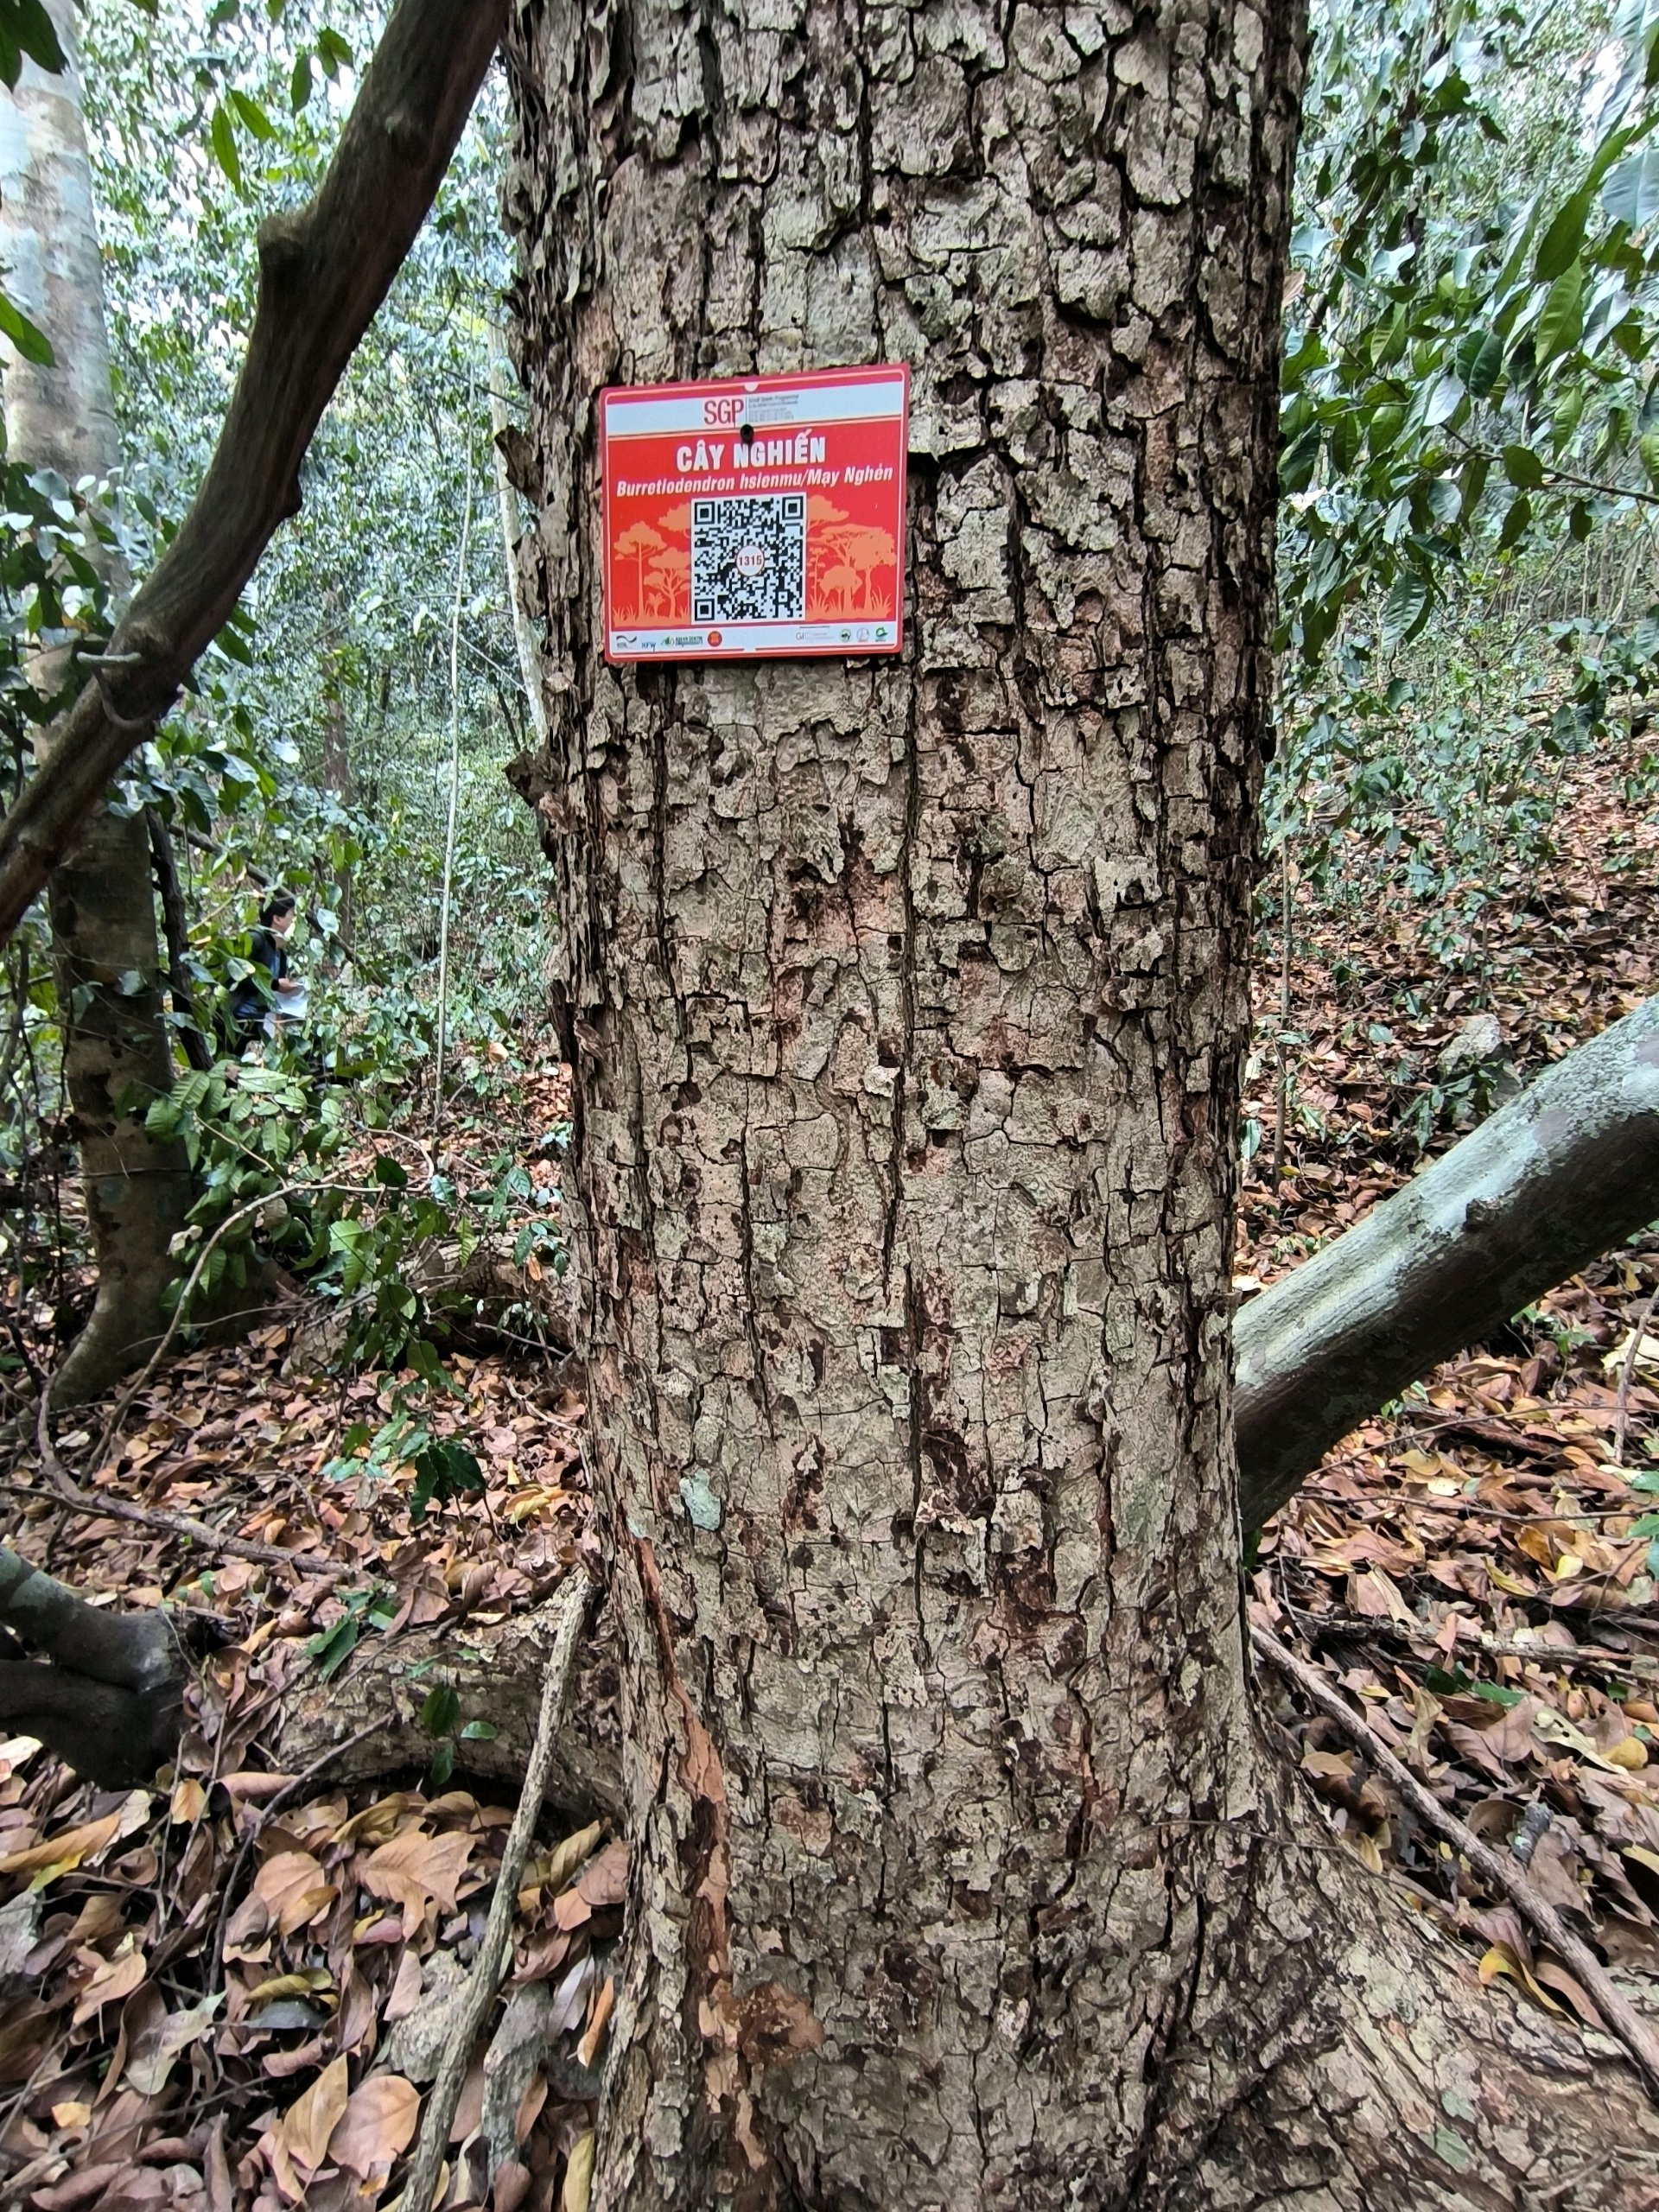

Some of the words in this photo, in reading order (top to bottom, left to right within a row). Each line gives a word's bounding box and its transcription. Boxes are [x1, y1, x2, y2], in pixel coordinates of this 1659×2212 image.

[704, 399, 744, 426] SGP
[677, 439, 725, 473] CÂY
[733, 429, 826, 468] NGHIẾN
[739, 555, 762, 566] 1315
